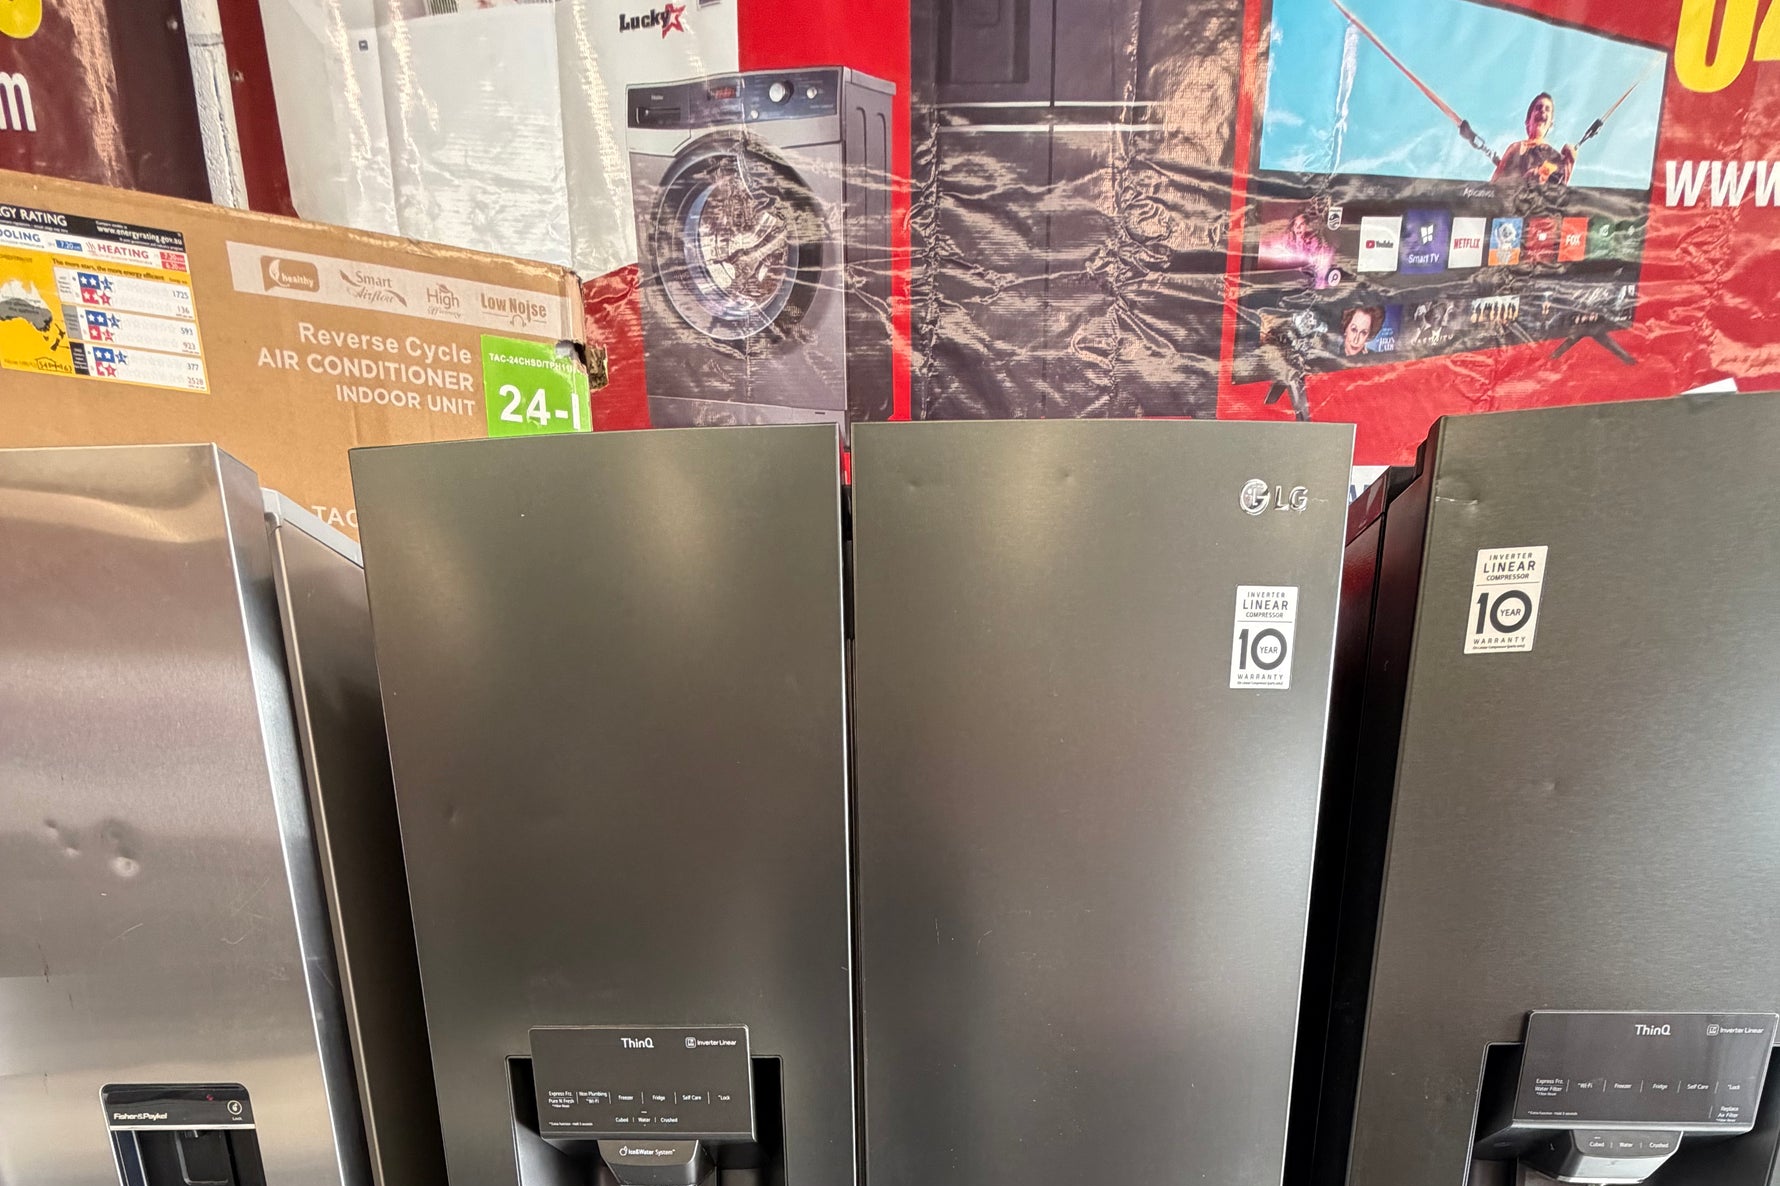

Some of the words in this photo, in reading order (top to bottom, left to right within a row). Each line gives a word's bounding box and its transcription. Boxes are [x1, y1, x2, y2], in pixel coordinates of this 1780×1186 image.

[619, 9, 670, 33] Lucky
[0, 206, 17, 219] GY
[20, 209, 68, 227] RATING
[1454, 238, 1480, 249] NETFLIX
[1566, 234, 1581, 247] FOX
[97, 244, 149, 259] HEATING
[1408, 254, 1429, 264] Smart
[1430, 254, 1439, 262] TV
[281, 273, 314, 287] healthy
[355, 271, 392, 288] Smart
[427, 286, 460, 310] High
[481, 292, 507, 312] Low
[509, 298, 548, 323] Noise
[298, 322, 399, 353] Reverse
[405, 336, 472, 364] Cycle
[258, 347, 300, 371] AIR
[306, 353, 474, 392] CONDITIONER
[335, 384, 421, 409] INDOOR
[427, 394, 476, 416] UNIT
[1274, 486, 1309, 512] LG
[1490, 552, 1533, 561] INVERTER
[1483, 561, 1536, 573] LINEAR
[1486, 573, 1530, 581] COMPRESSOR
[1243, 599, 1289, 610] LINEAR
[1476, 590, 1533, 634] 10
[1500, 608, 1521, 616] YEAR
[1473, 636, 1526, 645] WARRANTY
[1239, 628, 1288, 671] 10
[1259, 646, 1278, 654] YEAR
[1635, 1024, 1671, 1036] ThinQ
[1720, 1026, 1744, 1034] Inverter
[1744, 1026, 1764, 1034] Linear
[620, 1037, 655, 1048] ThinQ
[113, 1112, 168, 1121] Fisher&Paykel
